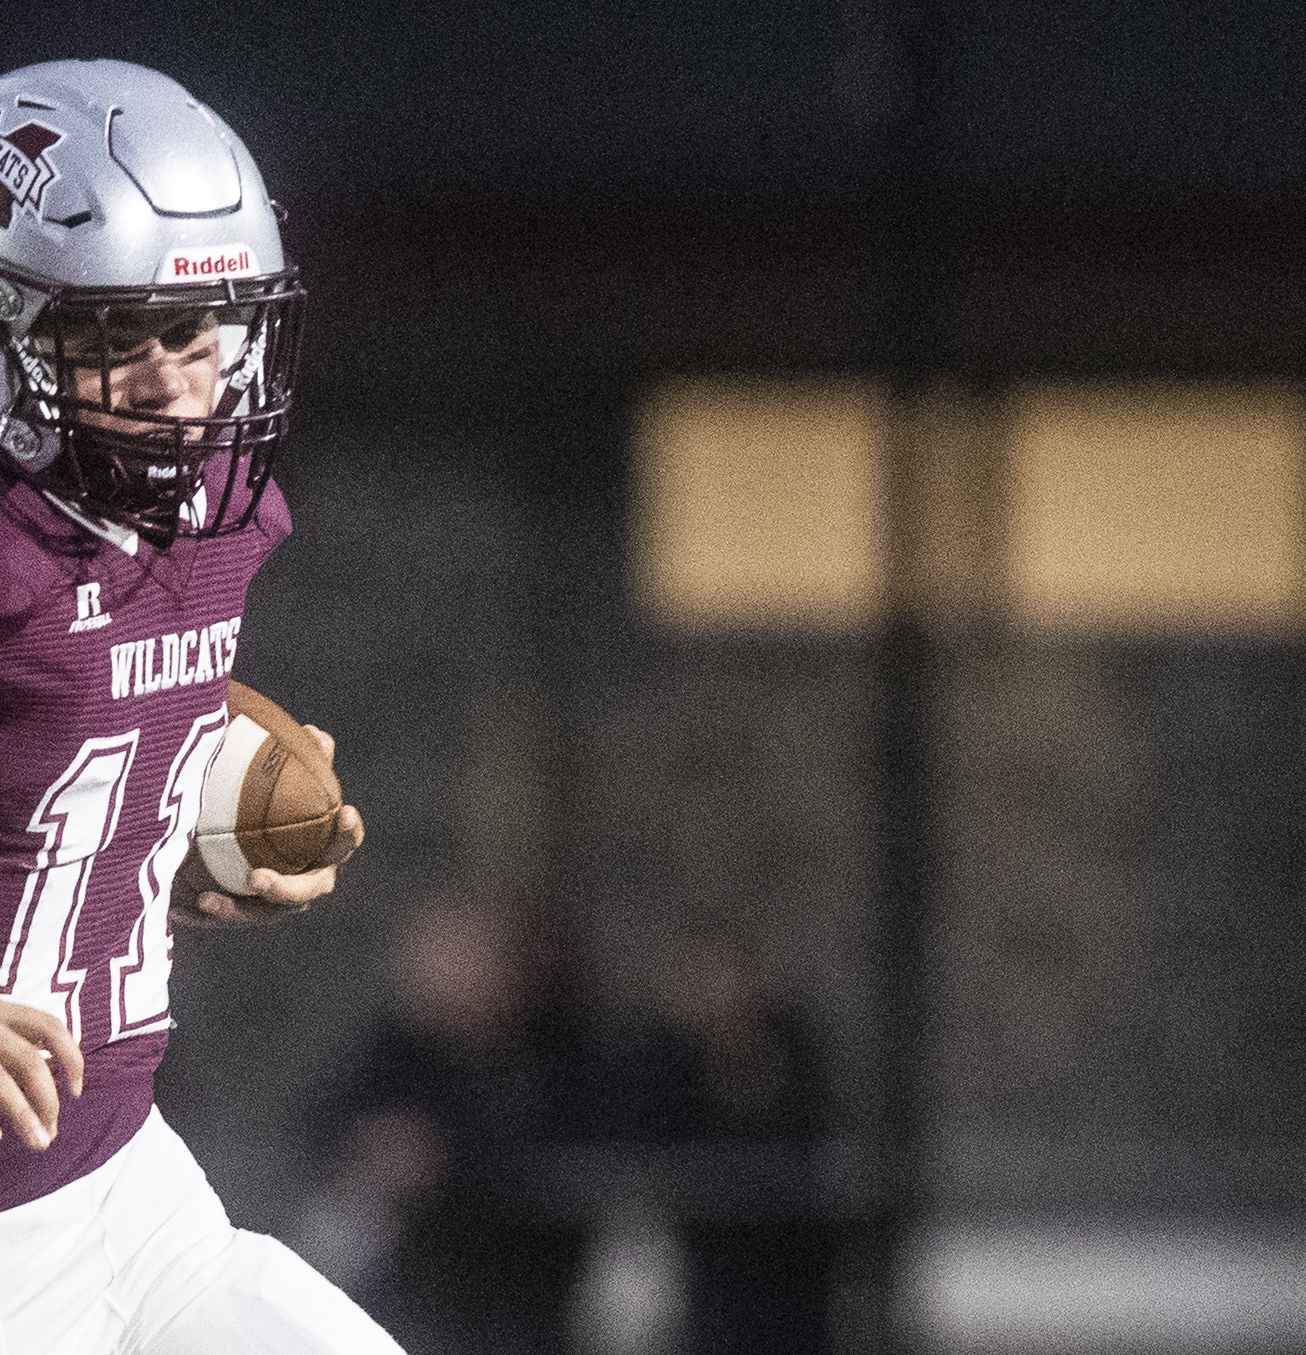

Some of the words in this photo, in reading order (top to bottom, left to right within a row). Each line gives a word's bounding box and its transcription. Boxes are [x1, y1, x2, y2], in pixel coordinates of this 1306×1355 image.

[173, 251, 251, 277] Riddell
[76, 581, 102, 621] R
[109, 615, 242, 700] WILDCATS
